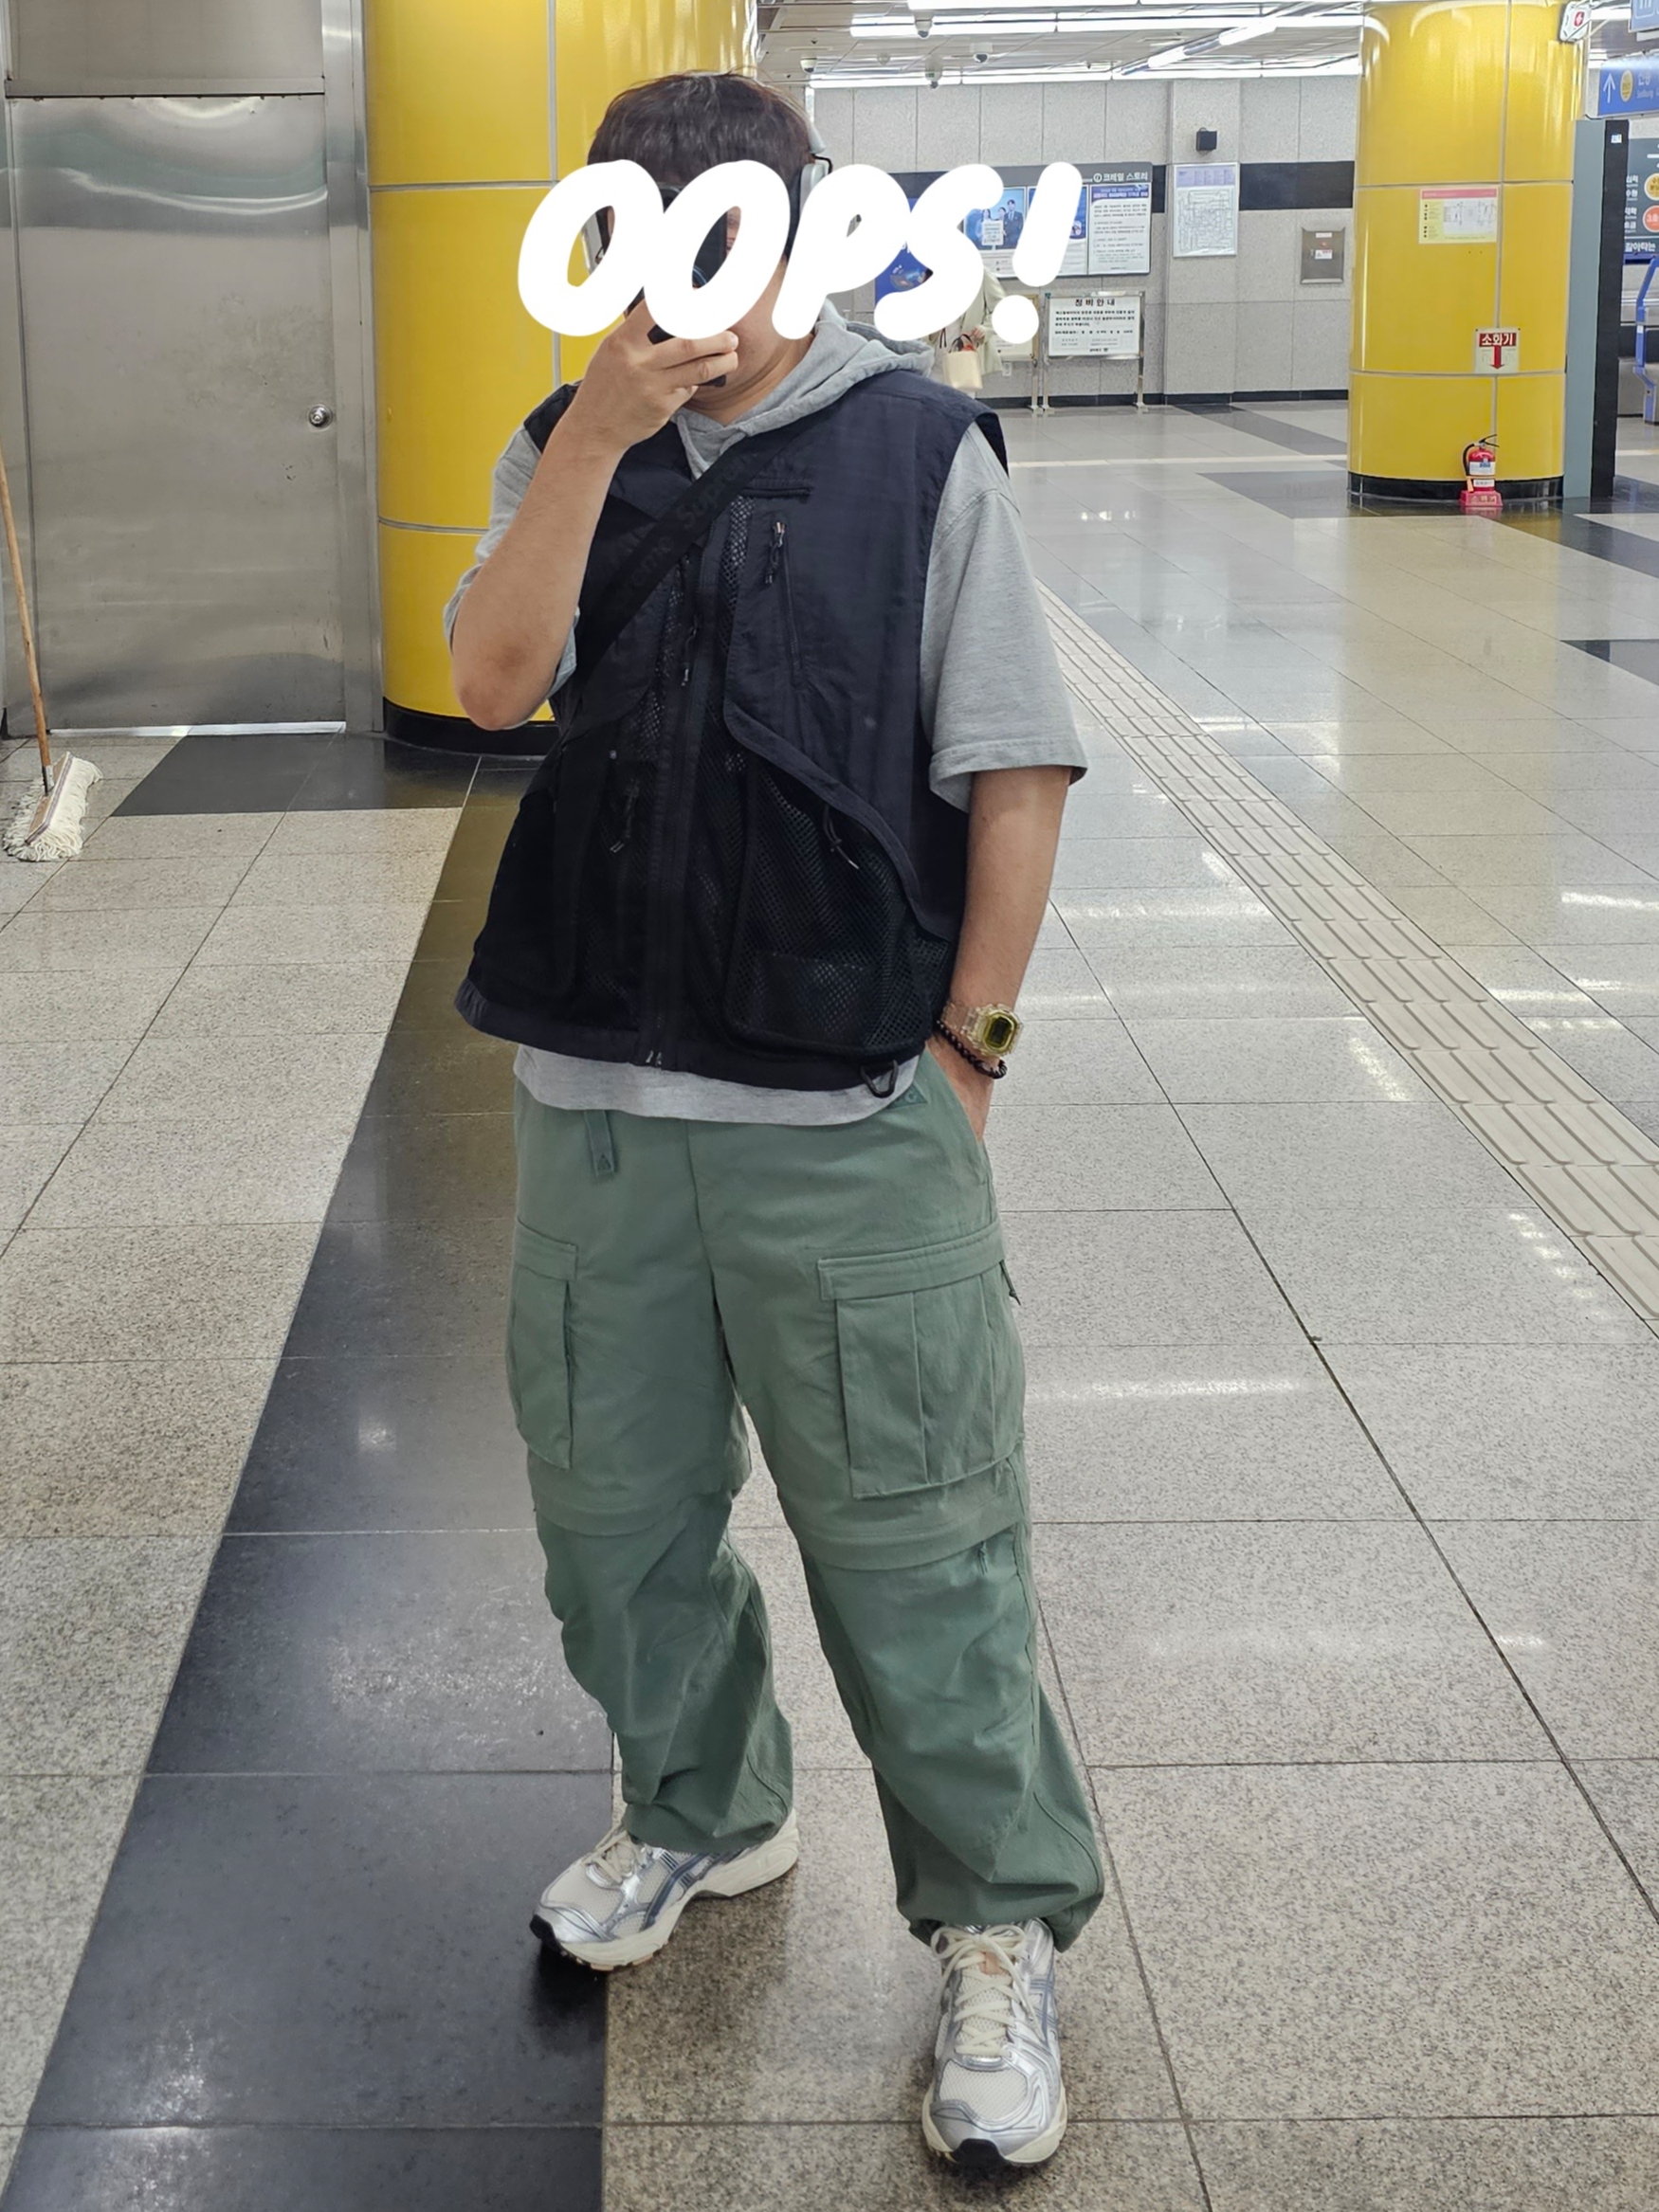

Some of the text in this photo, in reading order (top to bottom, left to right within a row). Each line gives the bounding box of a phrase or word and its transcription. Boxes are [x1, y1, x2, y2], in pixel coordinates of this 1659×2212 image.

[1103, 172, 1148, 183] 코레일 스토리
[1481, 333, 1514, 346] 소화기
